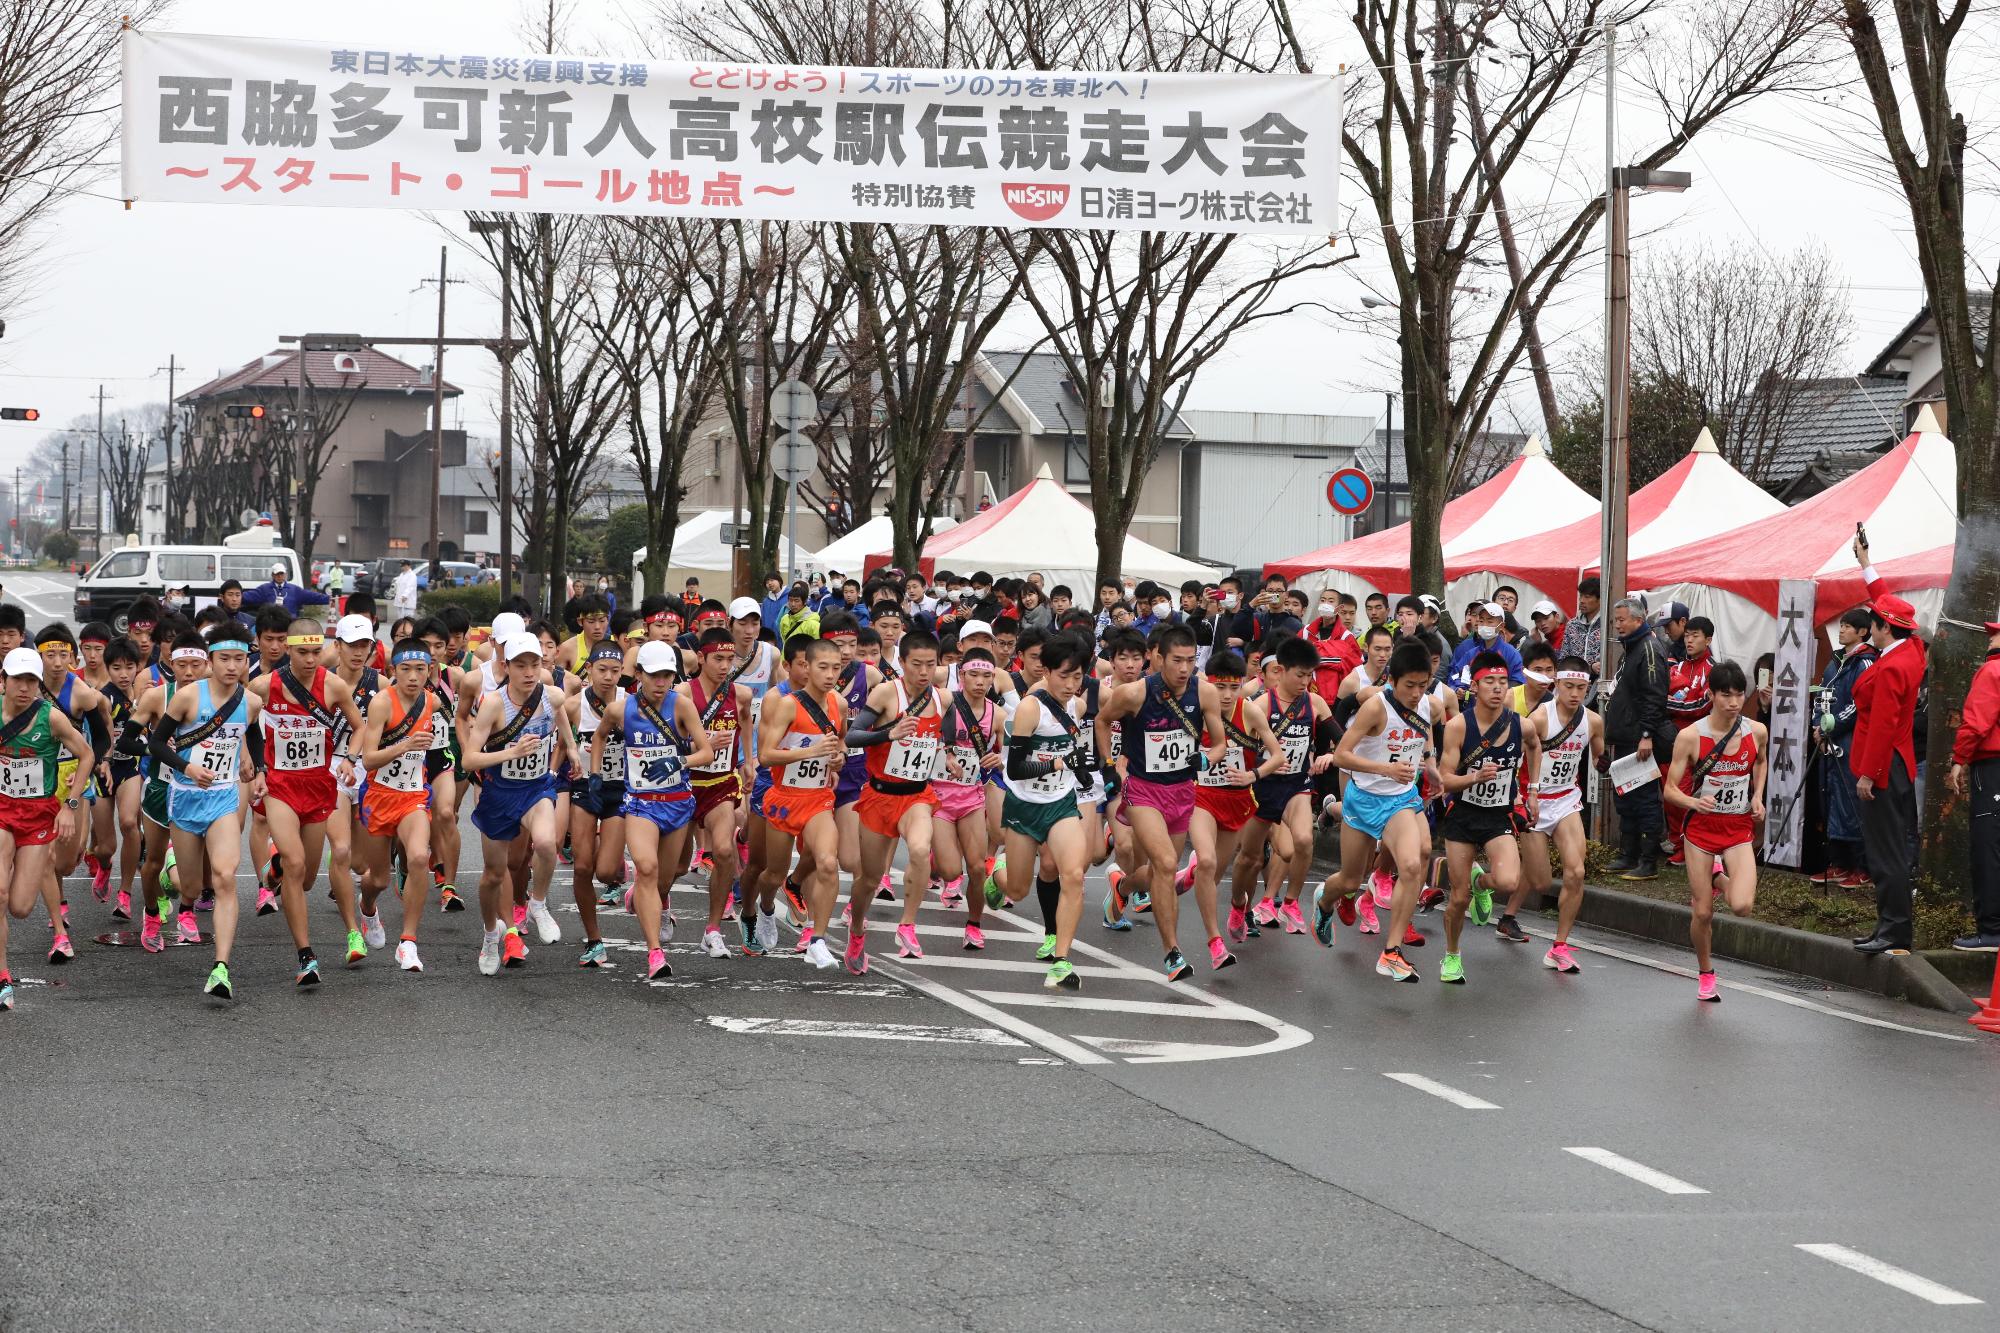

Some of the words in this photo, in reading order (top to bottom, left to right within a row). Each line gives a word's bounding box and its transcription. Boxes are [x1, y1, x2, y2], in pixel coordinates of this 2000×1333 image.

[332, 49, 649, 88] 東日本大震災復興支援
[159, 75, 1309, 179] 西脇多可新人高校駅伝競走大会
[852, 183, 976, 211] 特別協賛
[1007, 185, 1064, 208] NISSIN
[1081, 186, 1314, 226] 日清ヨーク株式会社
[278, 718, 318, 729] 大牟田
[1769, 597, 1805, 847] 大会本部
[210, 727, 240, 739] 島工
[294, 730, 322, 739] 日清ヨーク
[286, 741, 320, 760] 68-1
[603, 747, 625, 755] 清ヨーク
[644, 748, 673, 758] 日清ヨーク
[1158, 742, 1191, 761] 40-1
[1281, 748, 1303, 765] 4-1
[202, 751, 232, 771] 57-1
[507, 752, 546, 770] 103-1
[601, 757, 624, 772] 5-1
[797, 759, 828, 778] 56-1
[902, 750, 931, 770] 14-1
[1208, 760, 1240, 777] 251
[388, 759, 416, 780] 3-1
[1550, 761, 1577, 778] 59-1
[1713, 789, 1744, 804] 48-1
